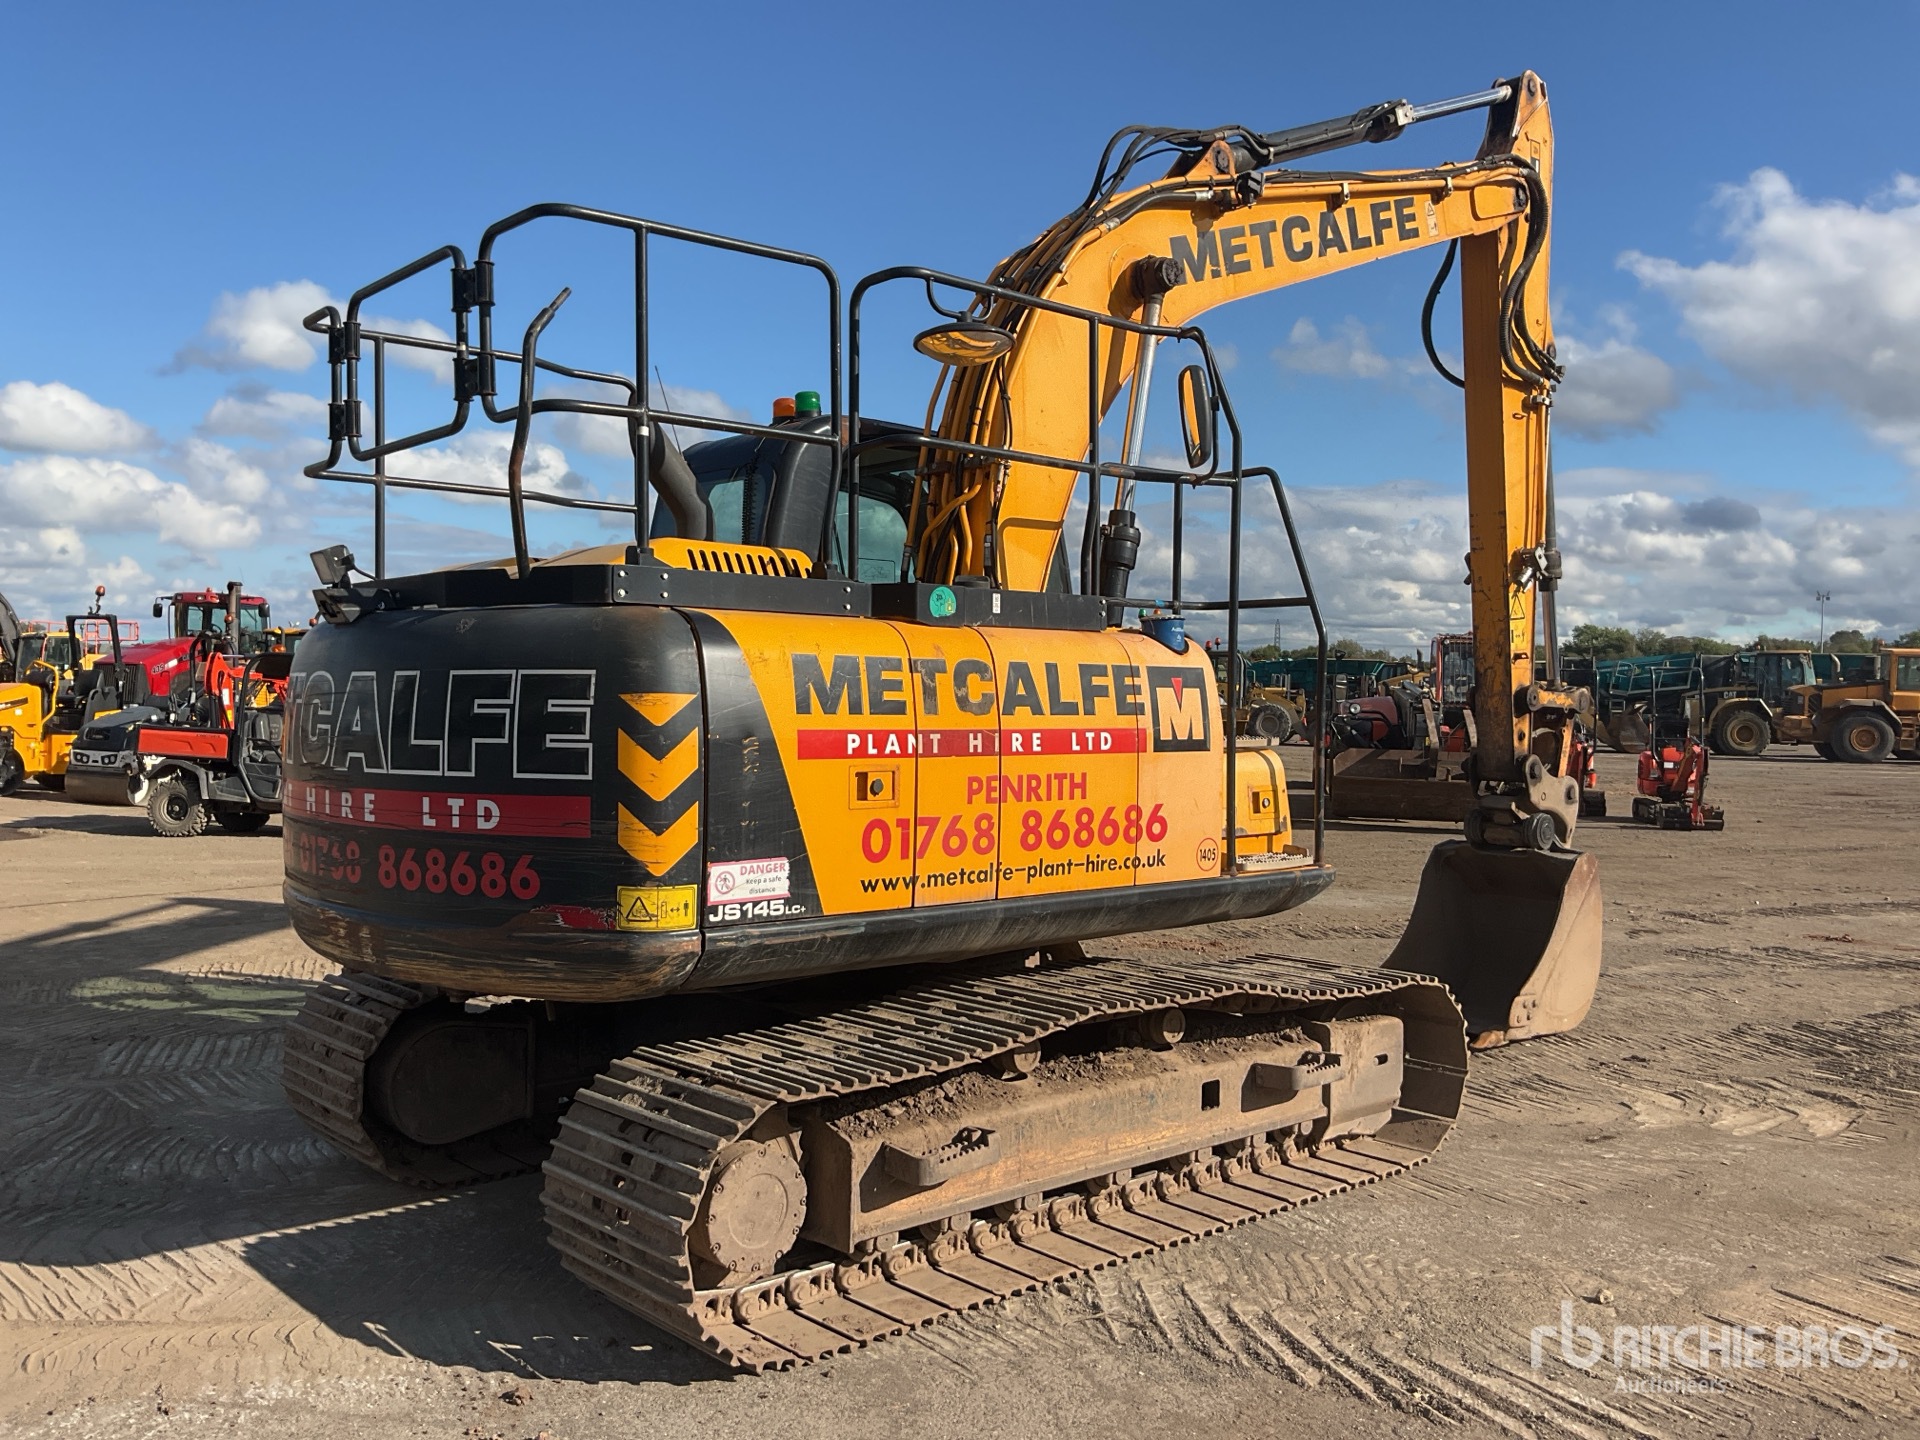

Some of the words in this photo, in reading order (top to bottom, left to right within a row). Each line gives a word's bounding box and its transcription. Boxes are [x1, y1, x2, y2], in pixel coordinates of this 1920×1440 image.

[1169, 197, 1420, 285] METCALFE
[791, 653, 1145, 717] METCALFE
[1723, 691, 1737, 699] CAT
[847, 733, 941, 755] PLANT
[969, 732, 1041, 753] HIRE
[1072, 731, 1113, 751] LTD
[967, 772, 1087, 804] PENRITH
[306, 787, 376, 822] HIRE
[422, 797, 500, 830] LTD
[861, 812, 995, 863] 01768
[1020, 803, 1168, 852] 868686
[740, 863, 787, 876] DANGER
[860, 849, 1166, 893] www.metcalfe-plant-hire.co.uk
[1199, 848, 1216, 862] 1405
[378, 844, 541, 900] 868686
[745, 877, 761, 887] Keep
[769, 875, 782, 883] safe
[749, 886, 776, 894] distance
